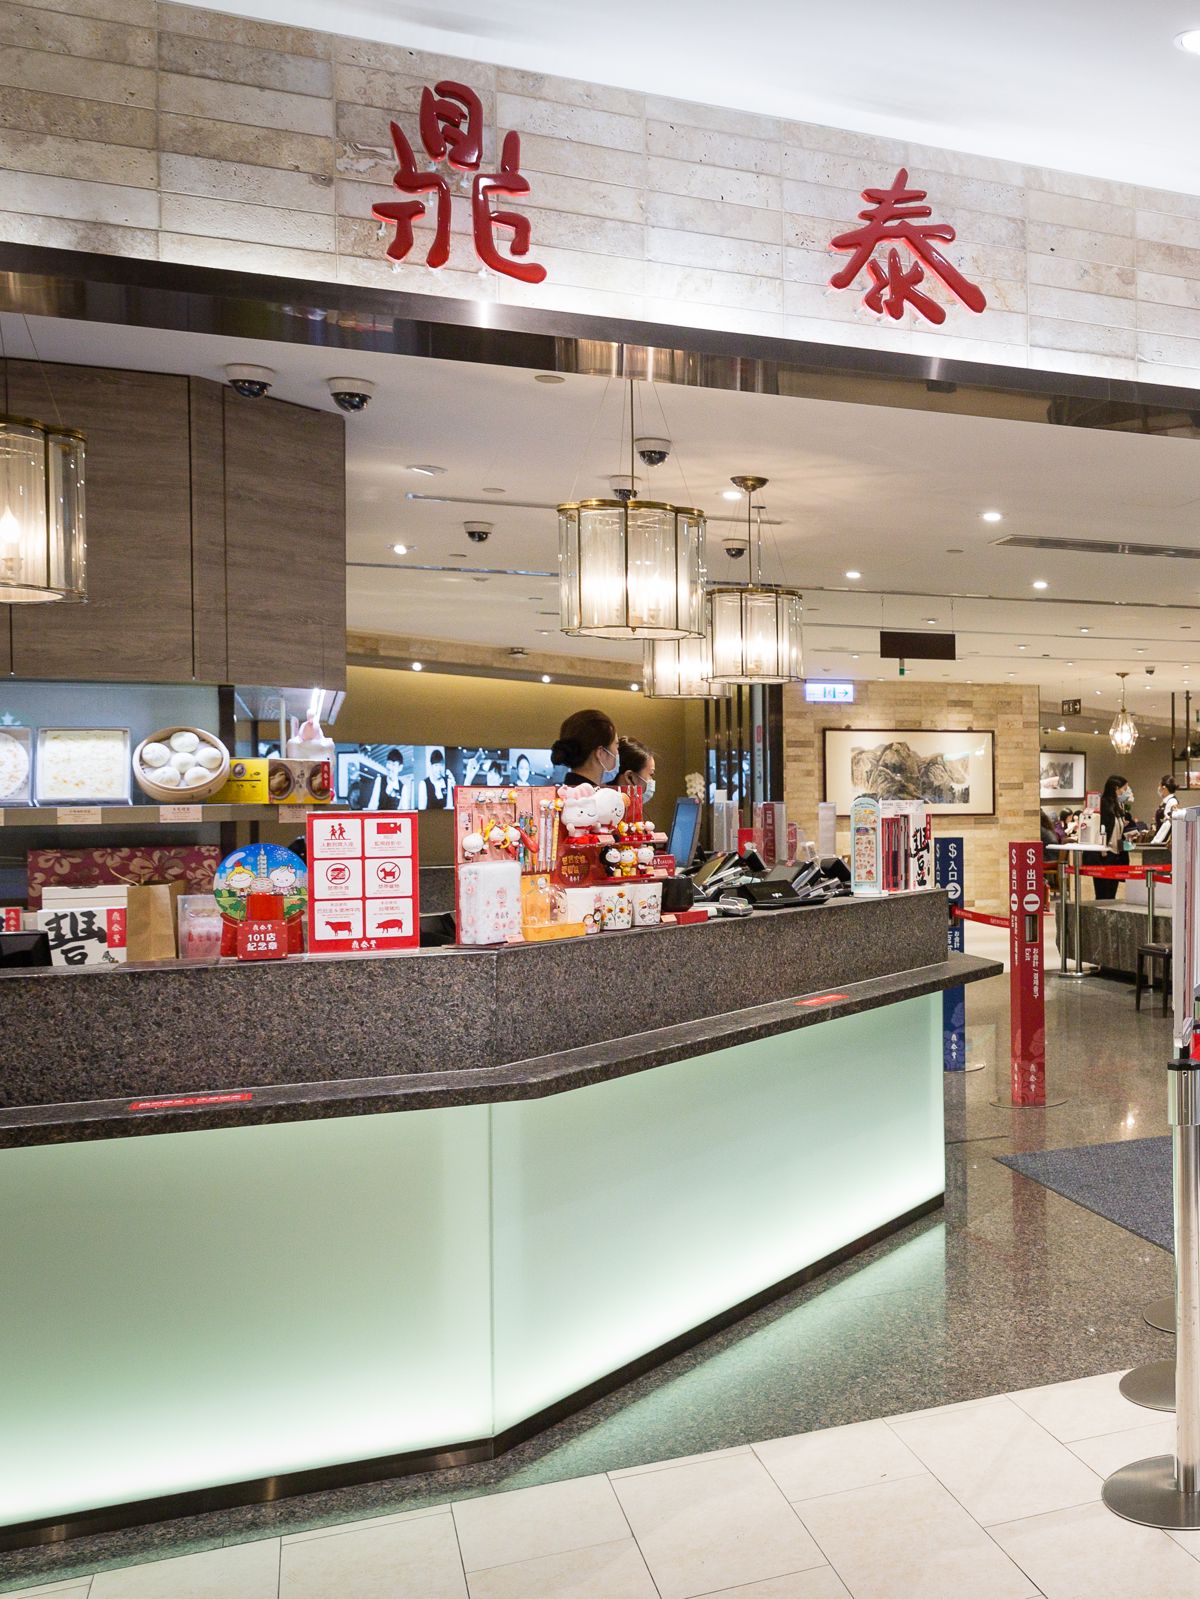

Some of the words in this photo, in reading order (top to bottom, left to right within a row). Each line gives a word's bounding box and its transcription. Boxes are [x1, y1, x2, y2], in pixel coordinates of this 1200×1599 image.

[948, 860, 958, 881] 入口
[1026, 868, 1037, 891] 出口
[247, 932, 276, 942] 101店
